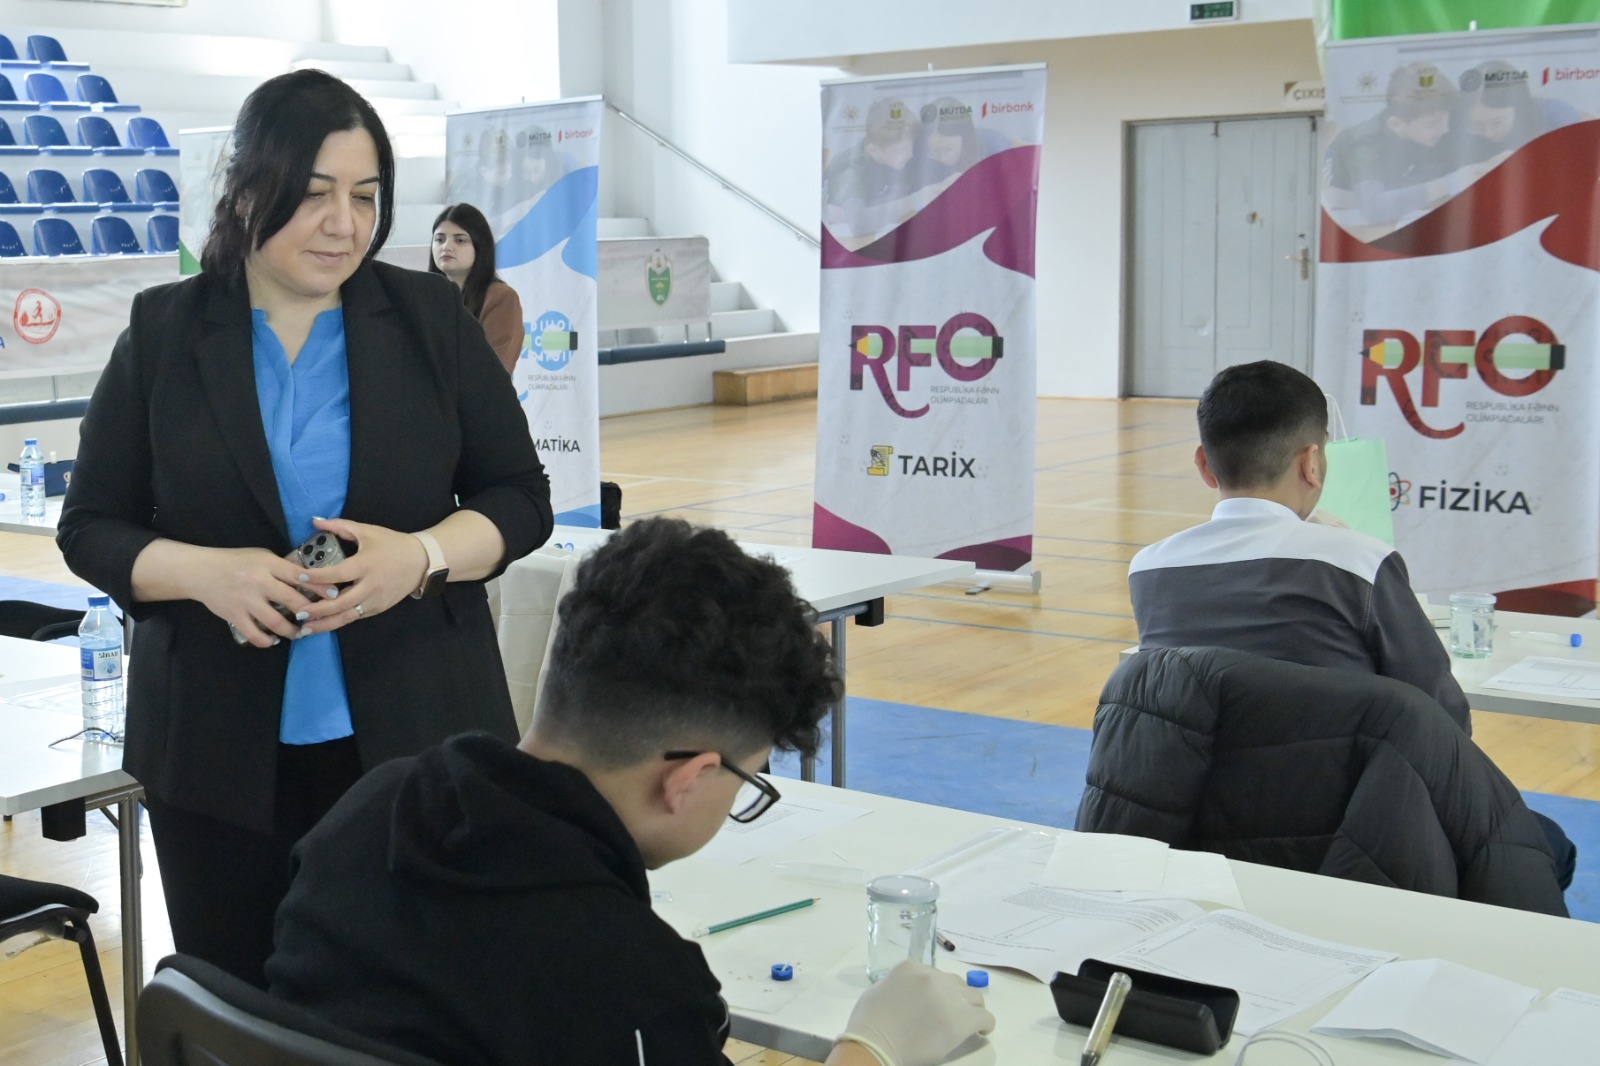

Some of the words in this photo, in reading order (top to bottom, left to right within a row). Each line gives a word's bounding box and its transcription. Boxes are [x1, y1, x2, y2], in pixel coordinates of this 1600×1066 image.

[1484, 70, 1529, 81] MÜTDA
[939, 105, 972, 116] MÜTDA
[991, 102, 1034, 115] birbank
[565, 129, 593, 140] birbank
[850, 312, 1000, 418] RFO
[1360, 315, 1560, 439] RFO
[898, 451, 976, 479] TARİX
[1418, 479, 1533, 516] FİZİKA
